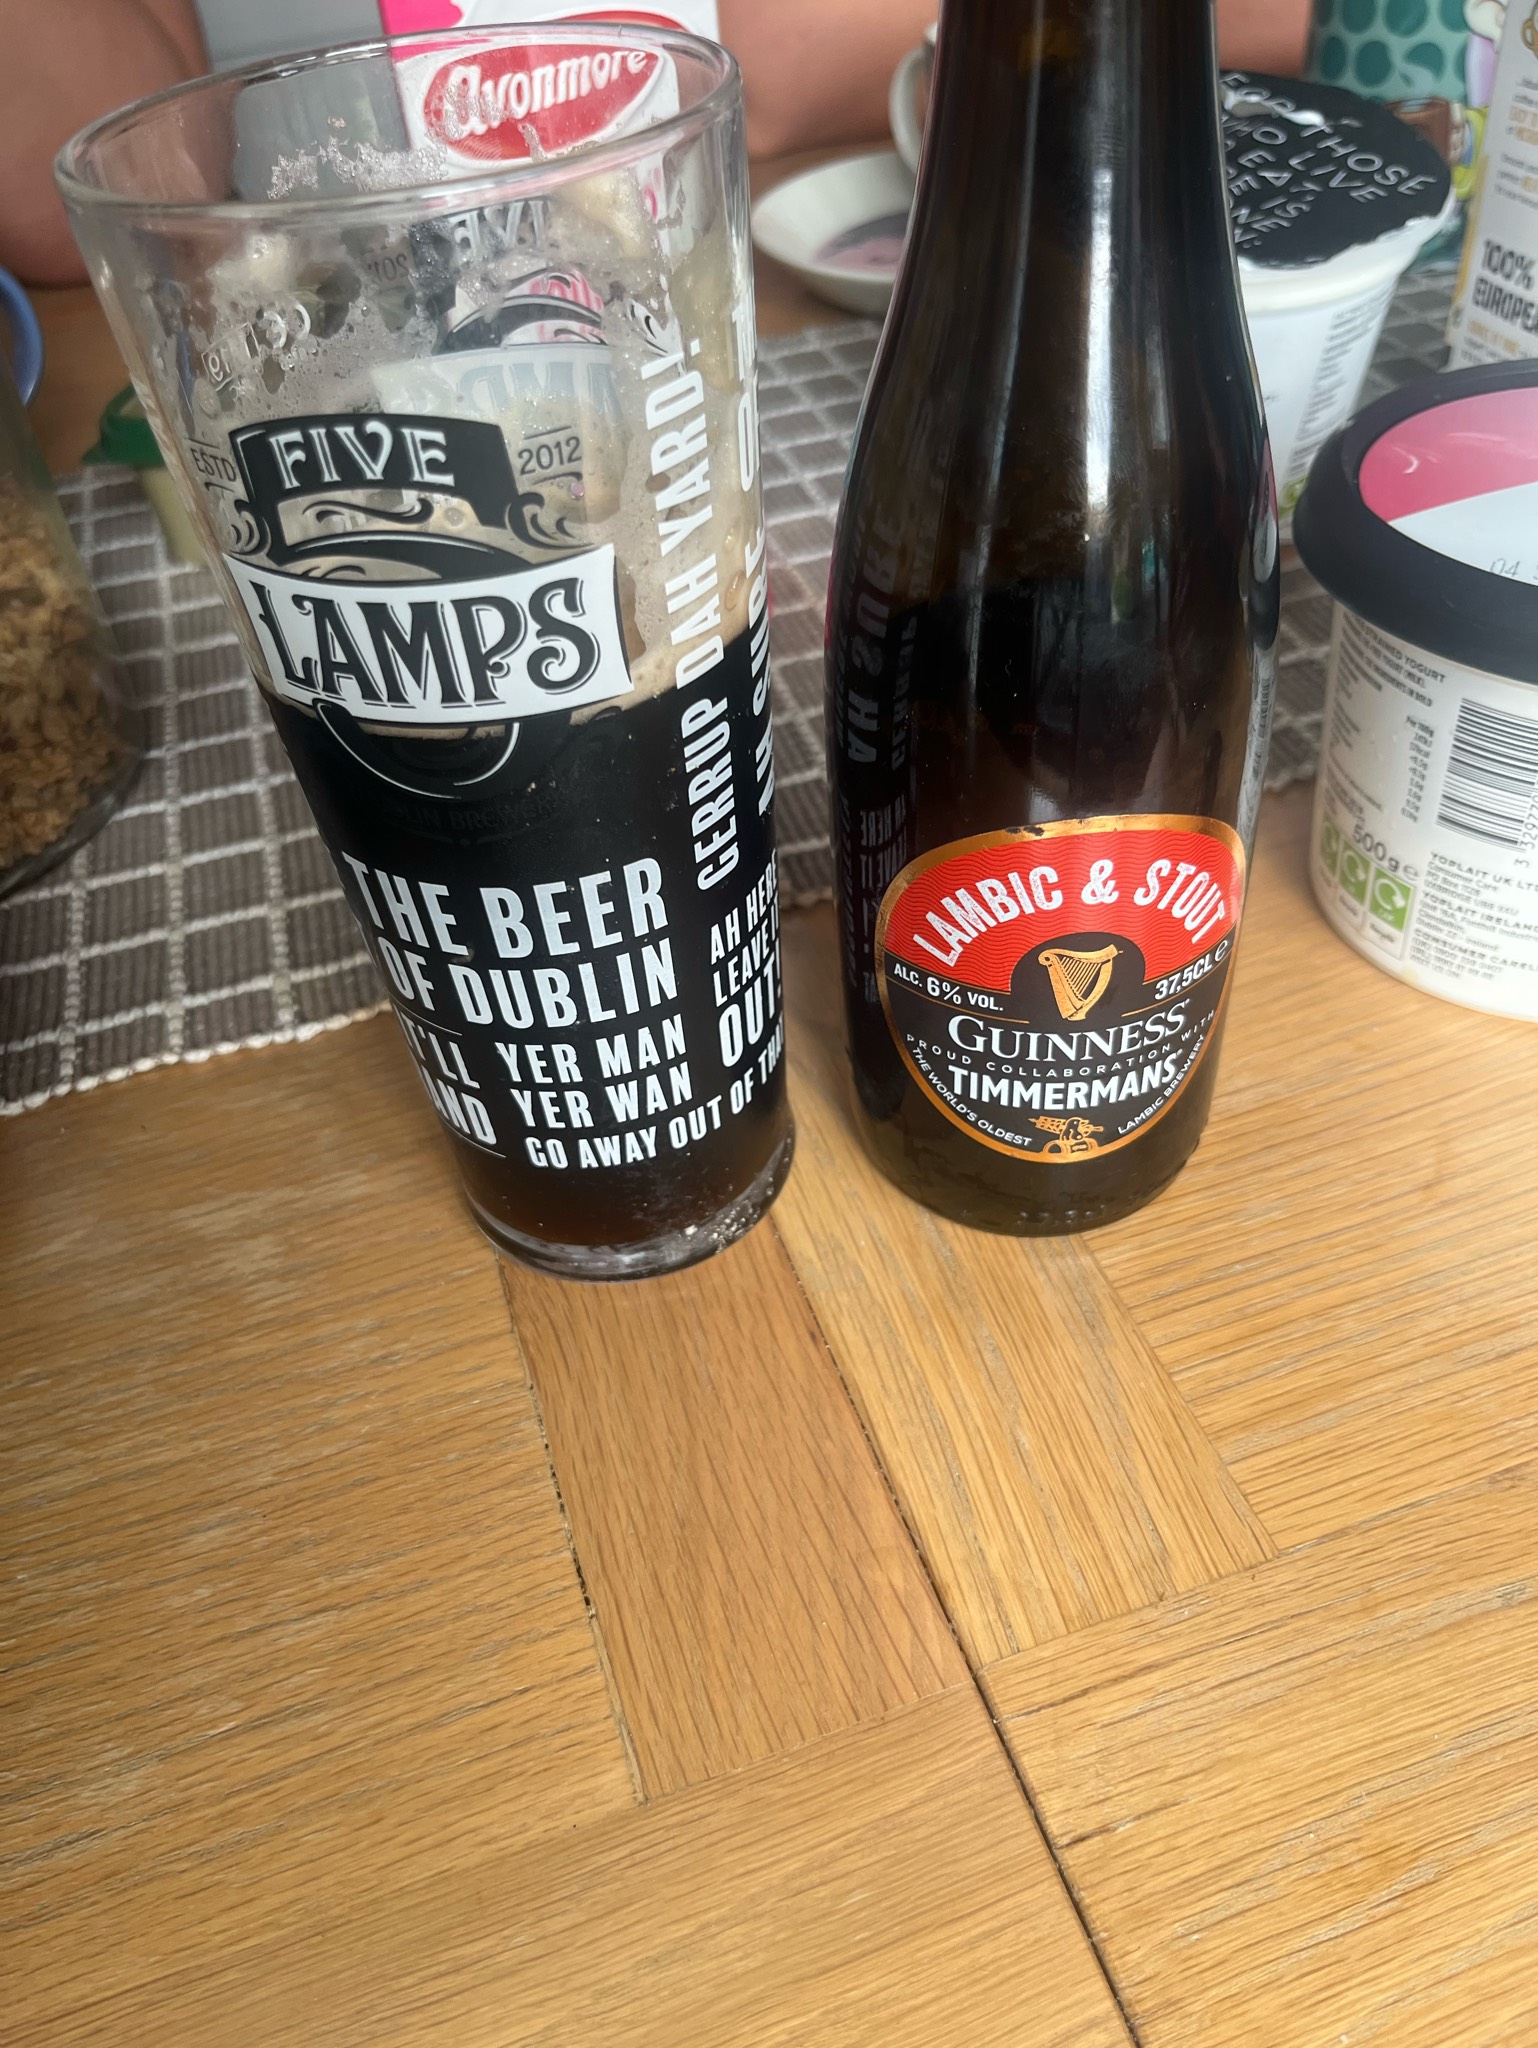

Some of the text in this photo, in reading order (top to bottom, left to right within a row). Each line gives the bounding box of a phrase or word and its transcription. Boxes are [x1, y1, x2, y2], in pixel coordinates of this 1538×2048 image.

[1288, 151, 1388, 203] LIVE
[190, 436, 583, 482] ESTD 2012
[269, 420, 455, 489] FIVE
[249, 577, 600, 710] LAMPS
[641, 337, 741, 891] GERRUP DAH YARD!
[1404, 653, 1447, 684] YOGURT
[342, 851, 669, 959] THE BEER
[711, 847, 779, 966] AH HERE
[913, 865, 1063, 967] LAMBIC
[1081, 858, 1119, 905] &
[1134, 858, 1226, 943] STOUT
[377, 936, 679, 1030] OF DUBLIN
[713, 918, 771, 1008] LEAVE
[894, 963, 923, 988] ALC.
[926, 976, 962, 1005] 6%
[967, 992, 1005, 1011] VOL.
[495, 1014, 687, 1085] YER MAN
[906, 1010, 1216, 1077] PROUD COLLABORATION WITH
[948, 1003, 1187, 1062] GUINNESS
[511, 1062, 694, 1129] YER WAN
[525, 1136, 569, 1169] GO
[578, 1126, 659, 1170] AWAY
[668, 1096, 723, 1149] OUT
[730, 1068, 755, 1115] OF
[912, 1048, 1033, 1148] THE WORLD'S OLDEST
[948, 1053, 1178, 1111] TIMMERMANS
[1117, 1034, 1205, 1134] LAMBIC BREWERY
